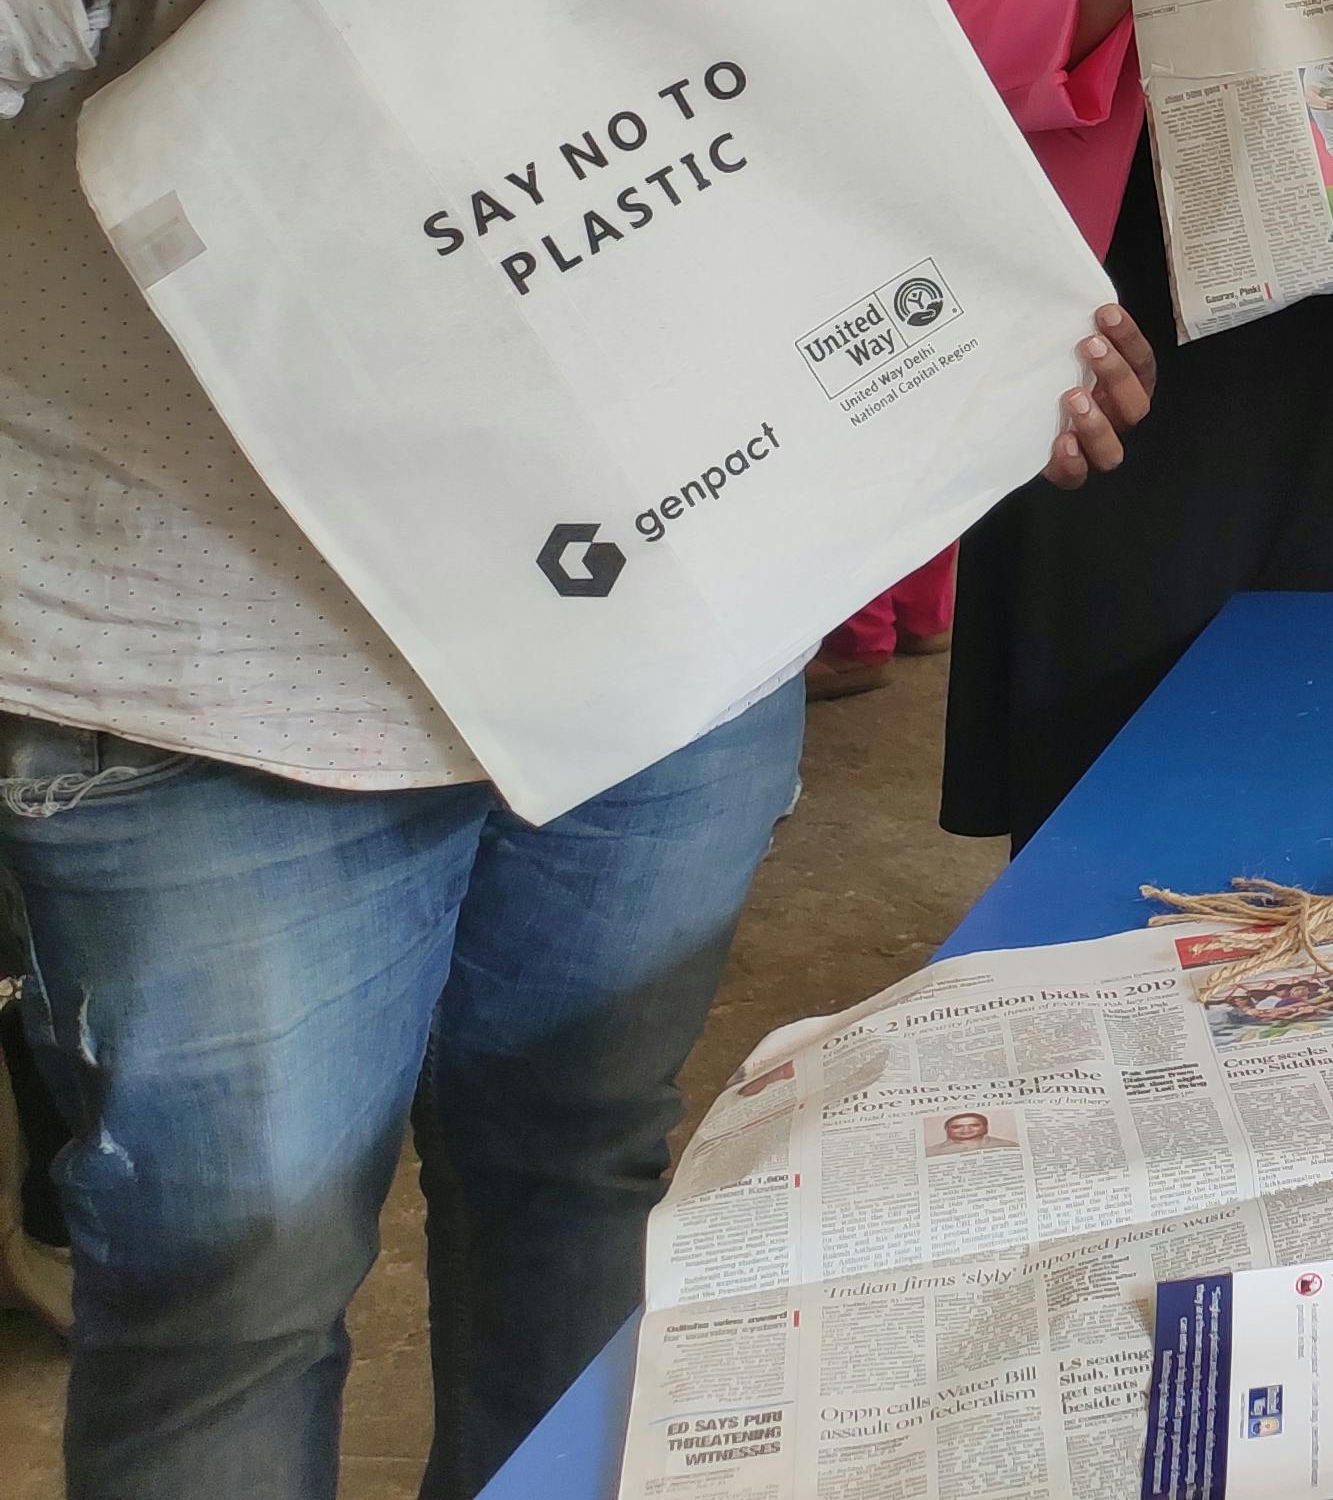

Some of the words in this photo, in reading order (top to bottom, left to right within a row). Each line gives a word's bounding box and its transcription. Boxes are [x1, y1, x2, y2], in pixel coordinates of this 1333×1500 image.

[423, 161, 545, 257] SAY
[560, 111, 648, 180] NO
[658, 61, 747, 120] TO
[500, 132, 747, 296] PLASTIC
[804, 303, 884, 363] United
[845, 328, 895, 367] Way
[839, 380, 878, 412] United
[878, 366, 904, 386] Way
[904, 343, 936, 370] Delhi
[850, 389, 899, 427] National
[899, 362, 939, 394] Capital
[940, 338, 979, 368] Region
[635, 422, 780, 542] genpact
[822, 1024, 878, 1050] Only
[884, 1020, 900, 1034] 2
[905, 993, 1036, 1024] infiltration
[1041, 988, 1091, 1003] bids
[1095, 988, 1117, 1000] in
[1124, 978, 1177, 998] 2019
[1224, 1054, 1275, 1069] Cong
[1276, 1047, 1327, 1062] seeks
[1225, 1068, 1264, 1080] into
[821, 1097, 902, 1120] before
[909, 1092, 978, 1106] move
[983, 1091, 1012, 1100] on
[1018, 1084, 1105, 1100] bizman
[878, 1084, 948, 1099] waits
[955, 1082, 983, 1092] for
[1032, 1068, 1103, 1086] probe
[902, 1272, 956, 1294] firms
[1021, 1239, 1109, 1277] imported
[1114, 1222, 1177, 1250] plastic
[1058, 1358, 1082, 1372] LS
[1060, 1369, 1108, 1387] Shah,
[820, 1405, 883, 1423] Oppn
[886, 1396, 931, 1415] calls
[937, 1377, 999, 1401] Water
[1005, 1364, 1037, 1384] Bill
[1060, 1385, 1089, 1402] get
[1093, 1379, 1138, 1395] seats
[1061, 1396, 1121, 1416] beside
[667, 1420, 690, 1437] ED
[694, 1415, 739, 1432] SAYS
[743, 1409, 783, 1428] PURI
[820, 1420, 891, 1442] assault
[895, 1416, 923, 1431] on
[929, 1387, 1036, 1420] federalism
[668, 1425, 782, 1451] THREATENING
[684, 1441, 780, 1467] WITNESSES
